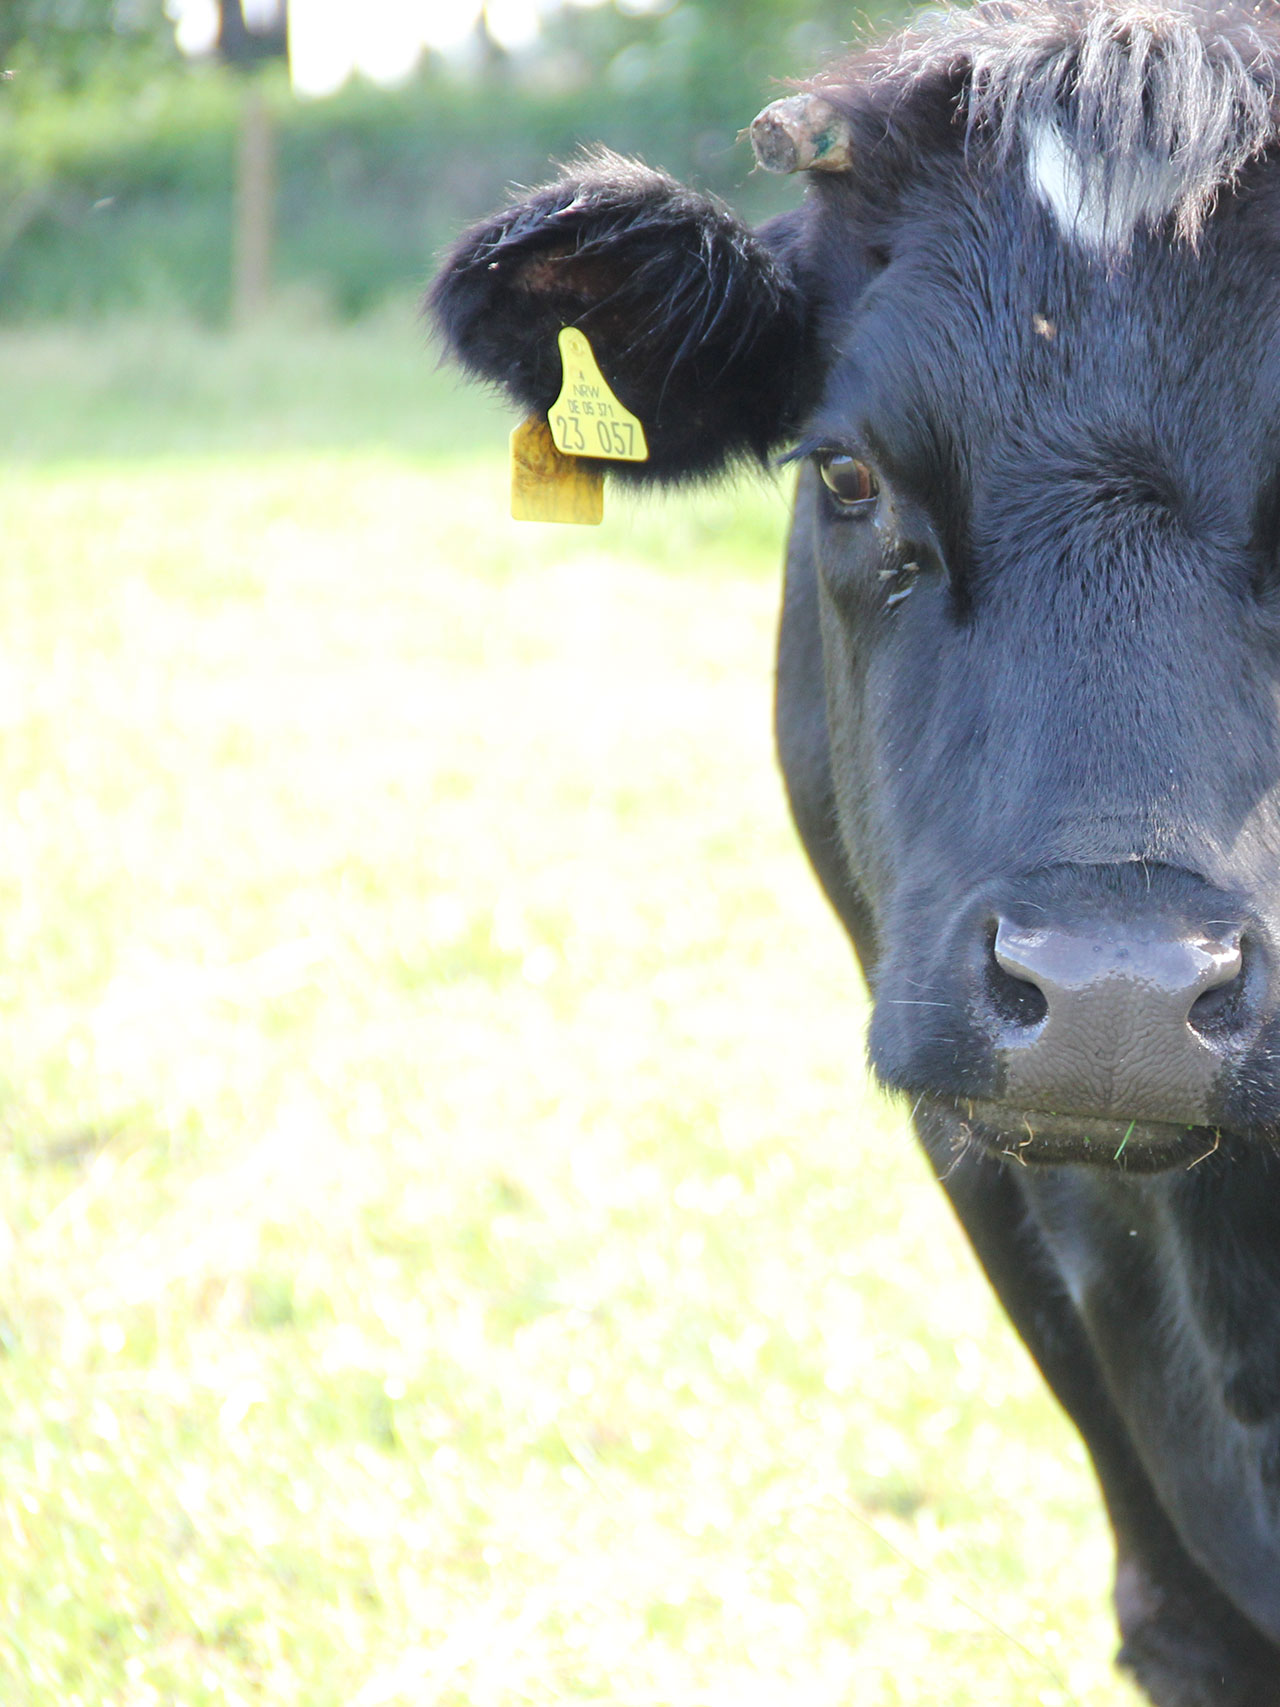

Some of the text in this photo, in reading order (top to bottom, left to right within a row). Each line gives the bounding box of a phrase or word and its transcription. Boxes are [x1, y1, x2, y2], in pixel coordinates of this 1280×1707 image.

[573, 384, 600, 398] NRW
[567, 399, 580, 414] DE
[557, 416, 633, 456] 23 057
